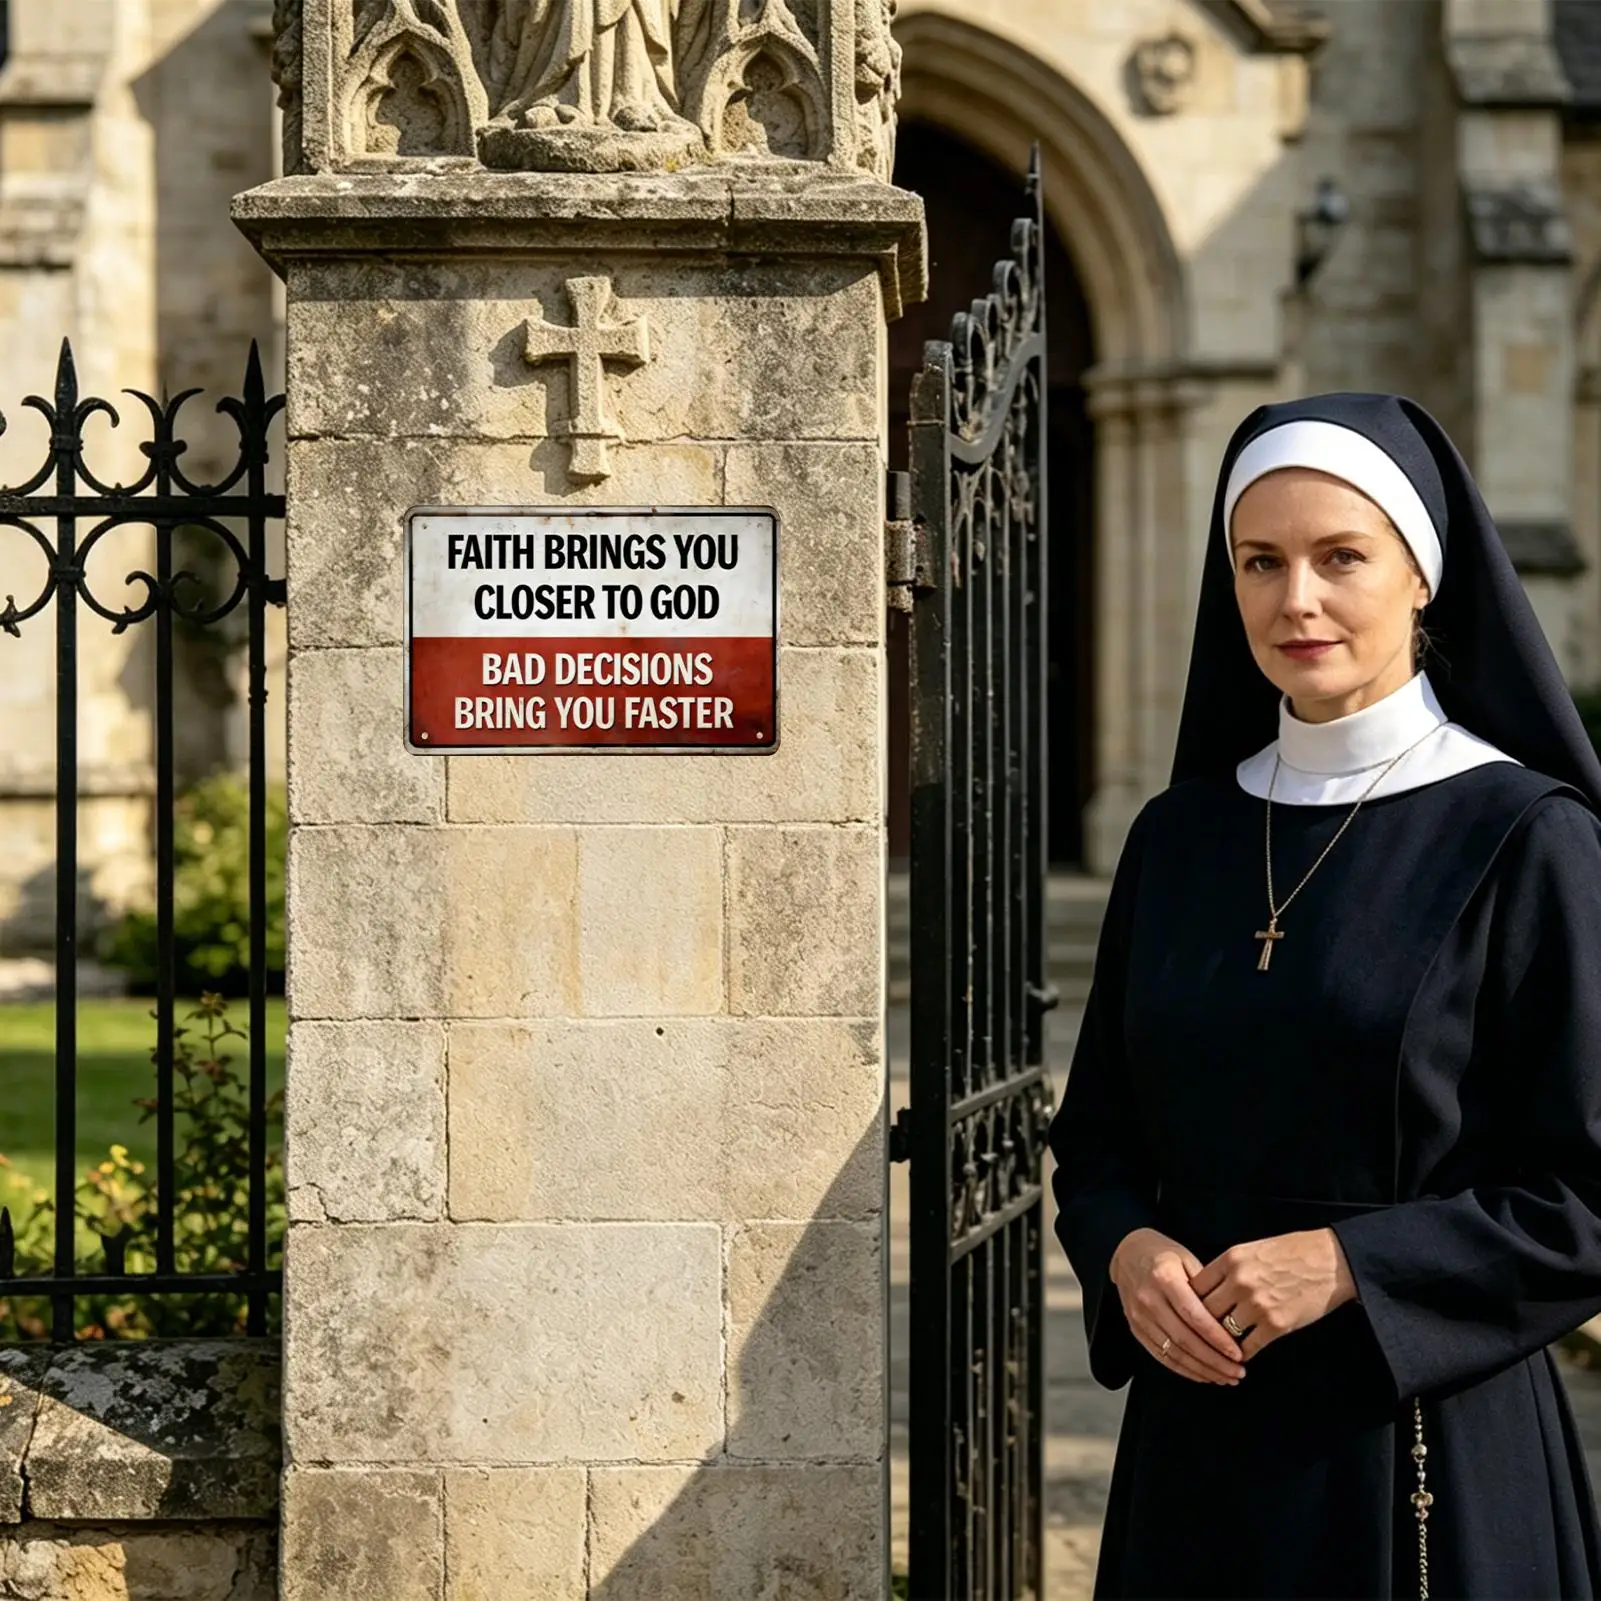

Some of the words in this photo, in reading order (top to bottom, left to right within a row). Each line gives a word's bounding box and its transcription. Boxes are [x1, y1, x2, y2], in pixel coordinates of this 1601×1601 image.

[448, 534, 534, 569] FAITH
[544, 534, 666, 570] BRINGS
[675, 534, 739, 570] YOU
[474, 584, 595, 620] CLOSER
[602, 584, 643, 620] TO
[650, 584, 720, 620] GOD
[482, 653, 546, 685] BAD
[555, 653, 714, 685] DECISIONS
[454, 697, 546, 729] BRING
[553, 697, 616, 730] YOU
[625, 697, 734, 729] FASTER
